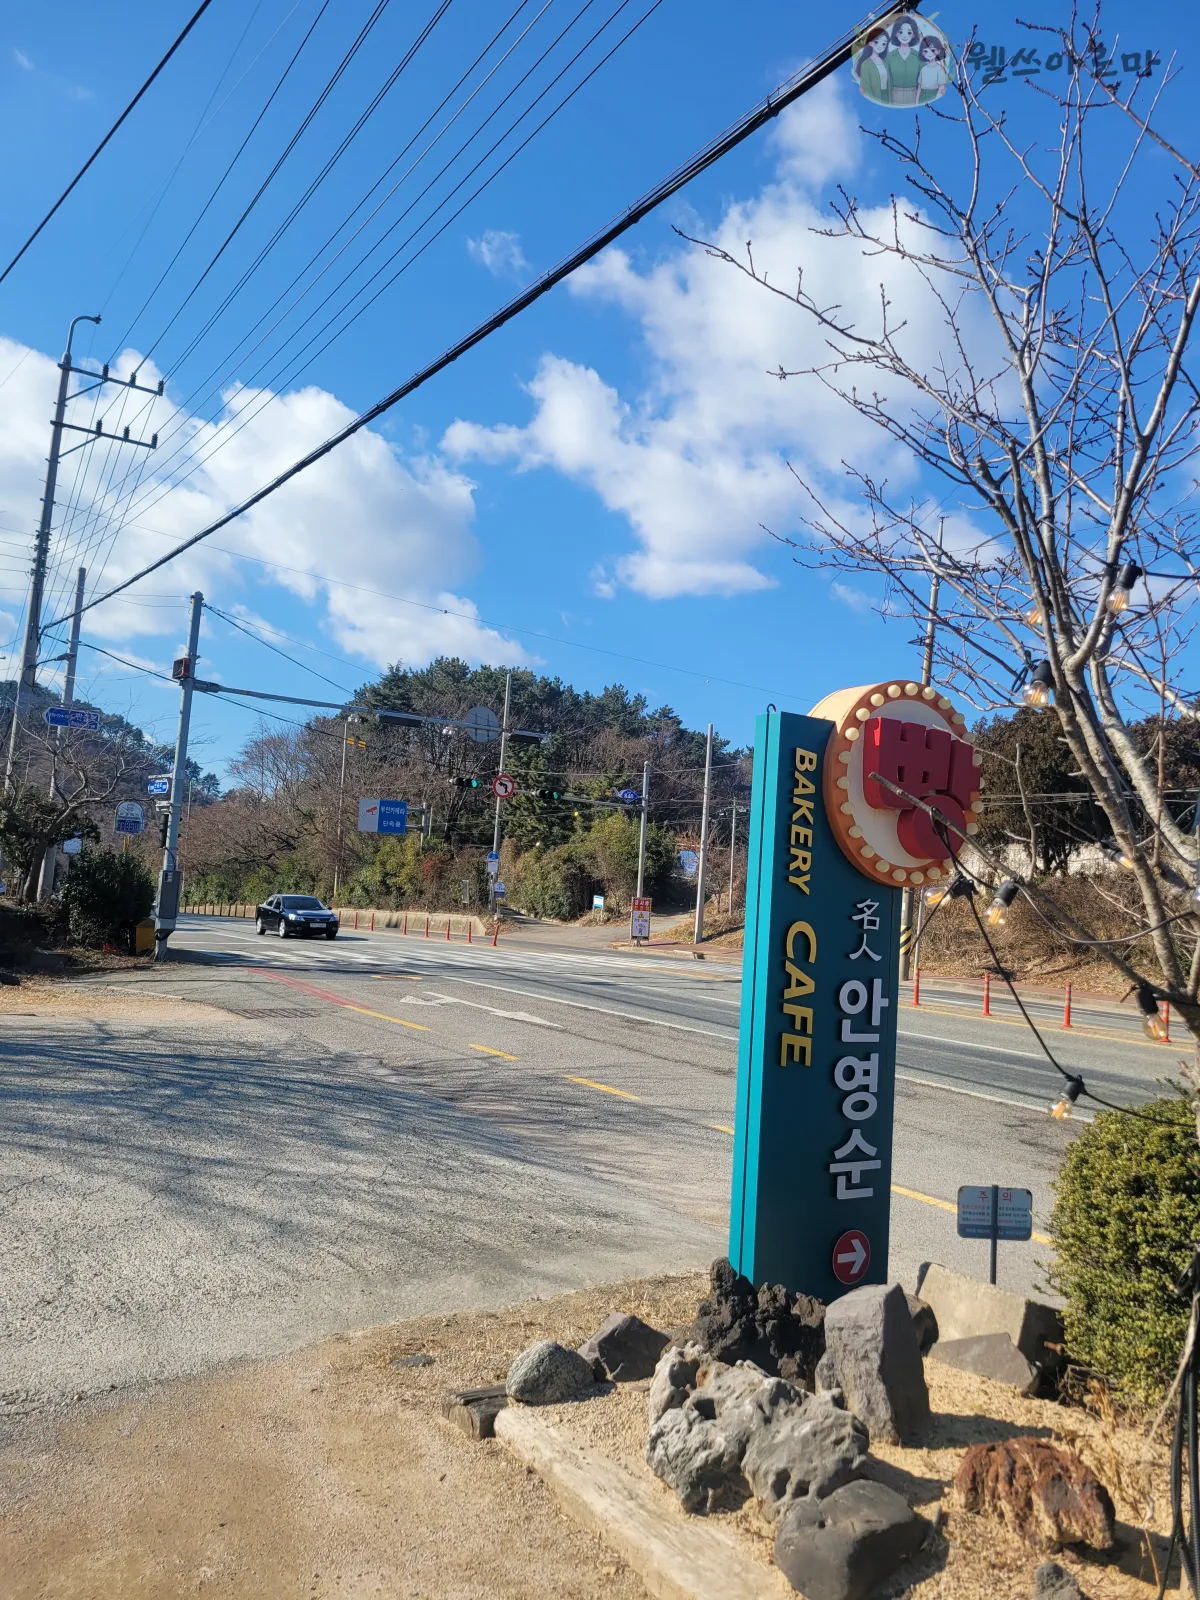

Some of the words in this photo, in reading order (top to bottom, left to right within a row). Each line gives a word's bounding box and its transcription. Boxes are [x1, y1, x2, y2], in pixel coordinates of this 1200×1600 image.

[380, 805, 405, 816] 무인카메라
[382, 820, 401, 828] 단속중
[788, 747, 818, 896] BAKERY
[849, 898, 882, 962] 名人
[780, 920, 818, 1068] CAFE
[829, 977, 889, 1201] 안영순
